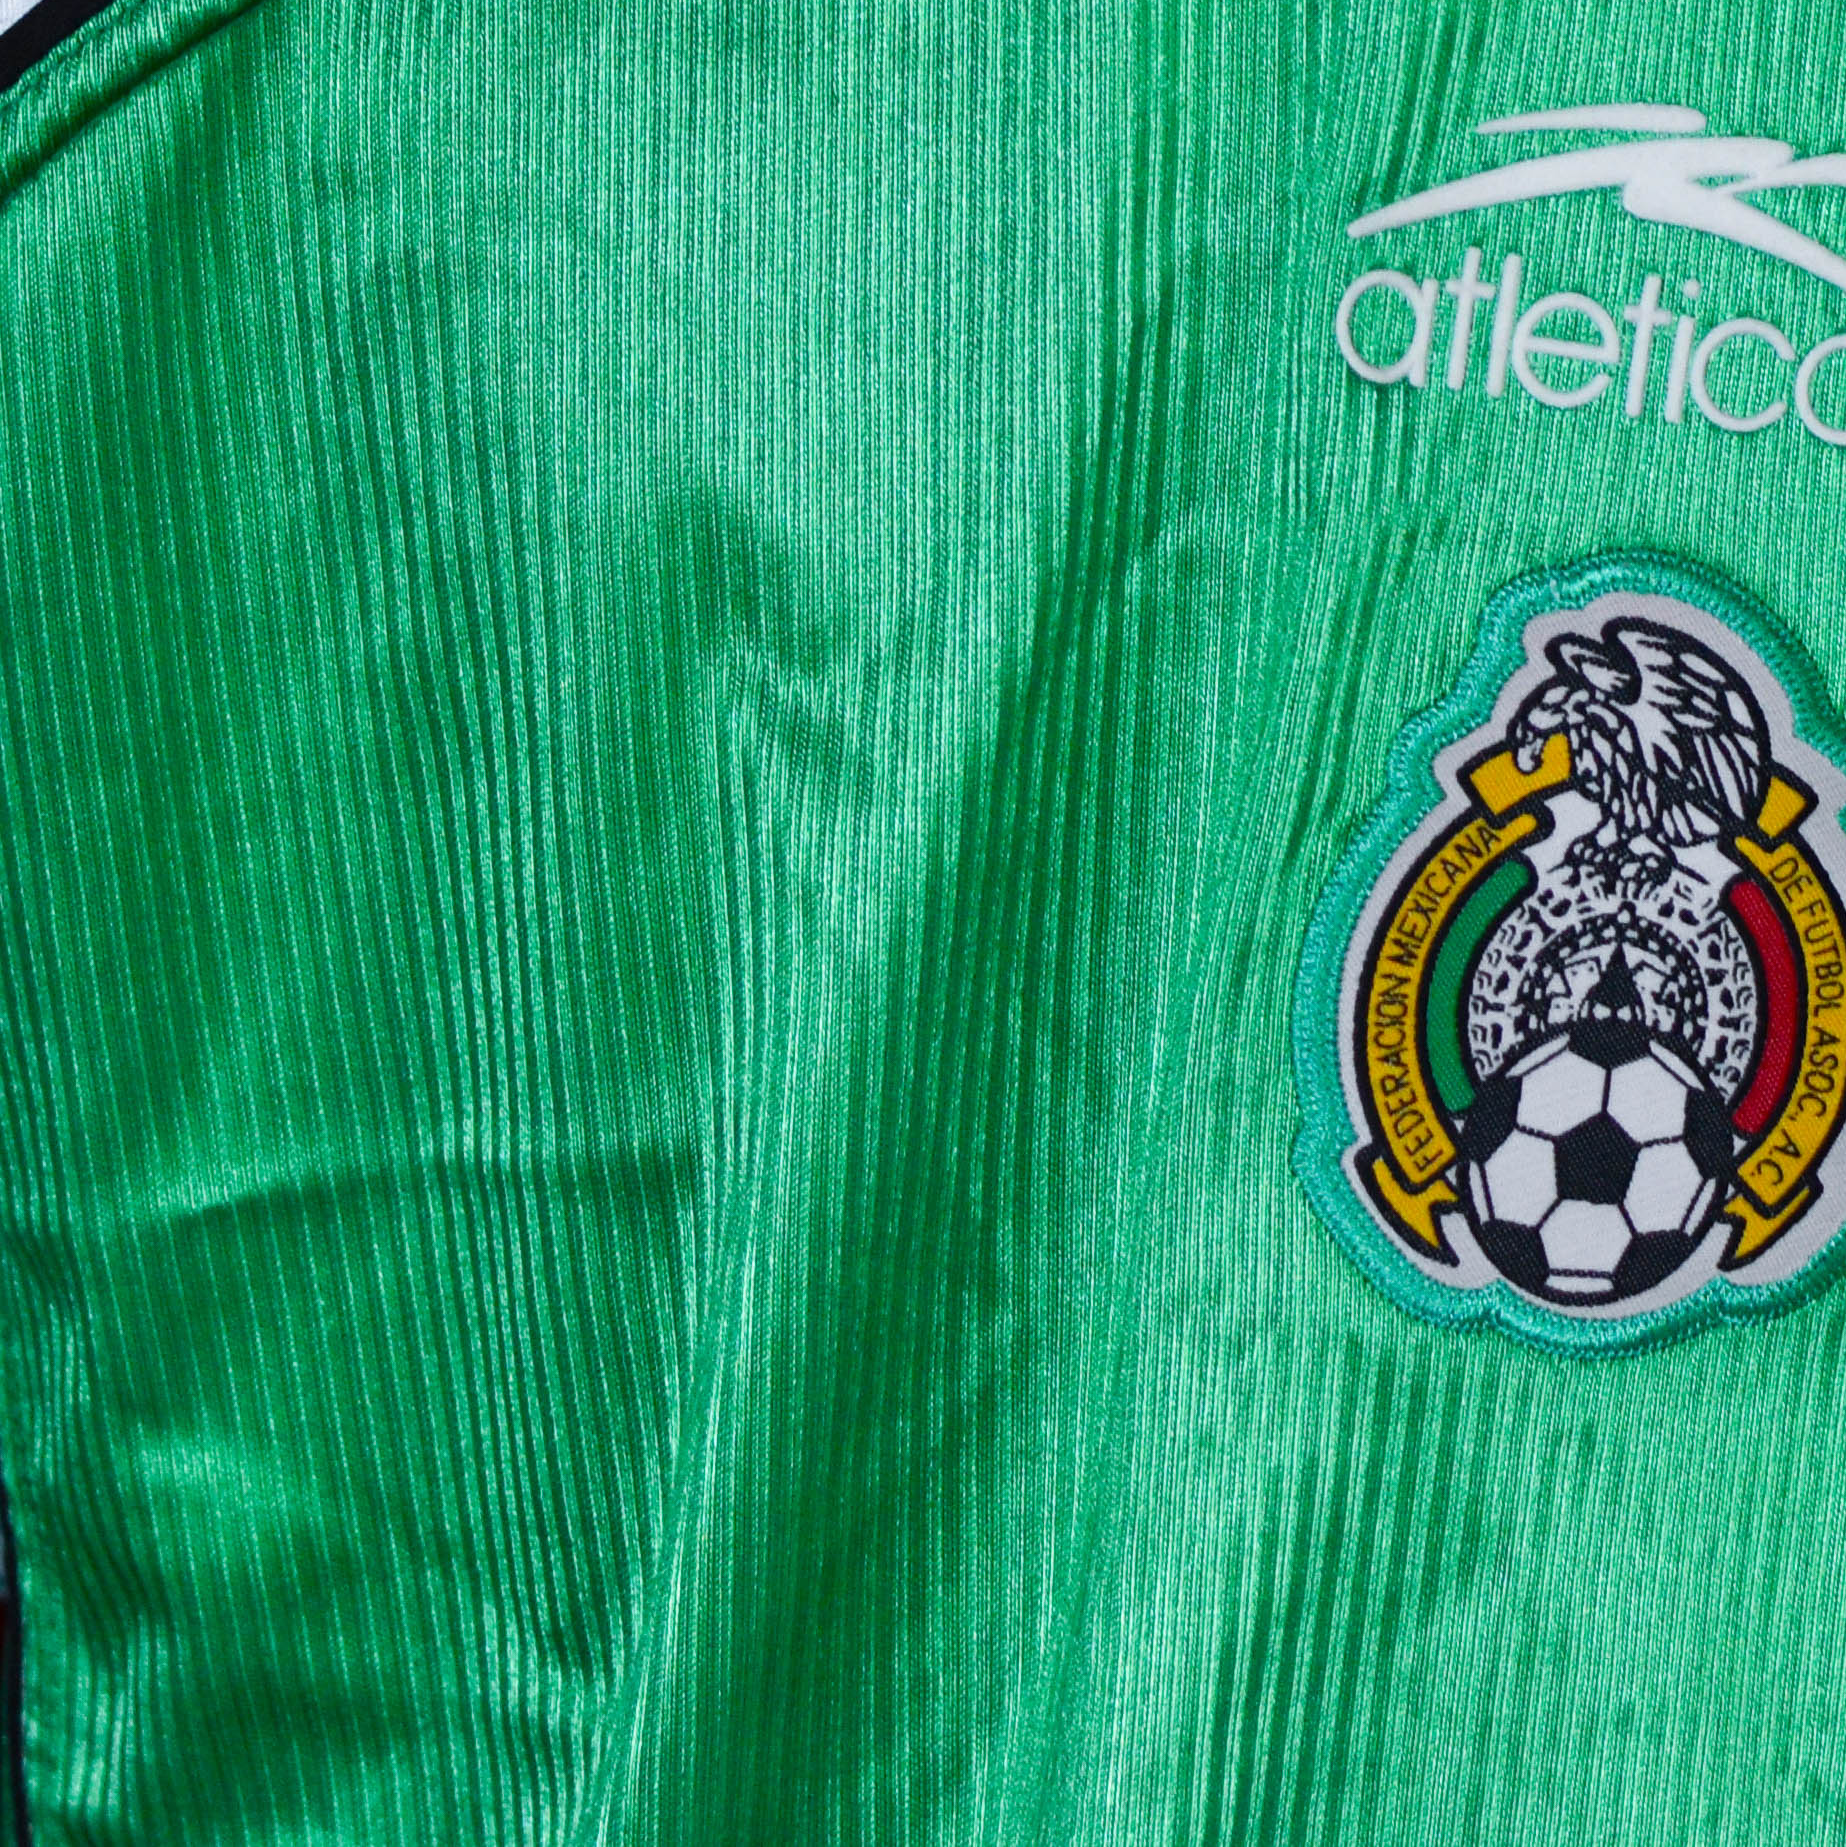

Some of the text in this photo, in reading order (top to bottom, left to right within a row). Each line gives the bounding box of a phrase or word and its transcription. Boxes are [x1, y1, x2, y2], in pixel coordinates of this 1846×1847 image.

[1374, 823, 1501, 1171] FEDERACION MEXICANA
[1769, 856, 1813, 903] DE
[1798, 900, 1845, 1018] FUTBOL
